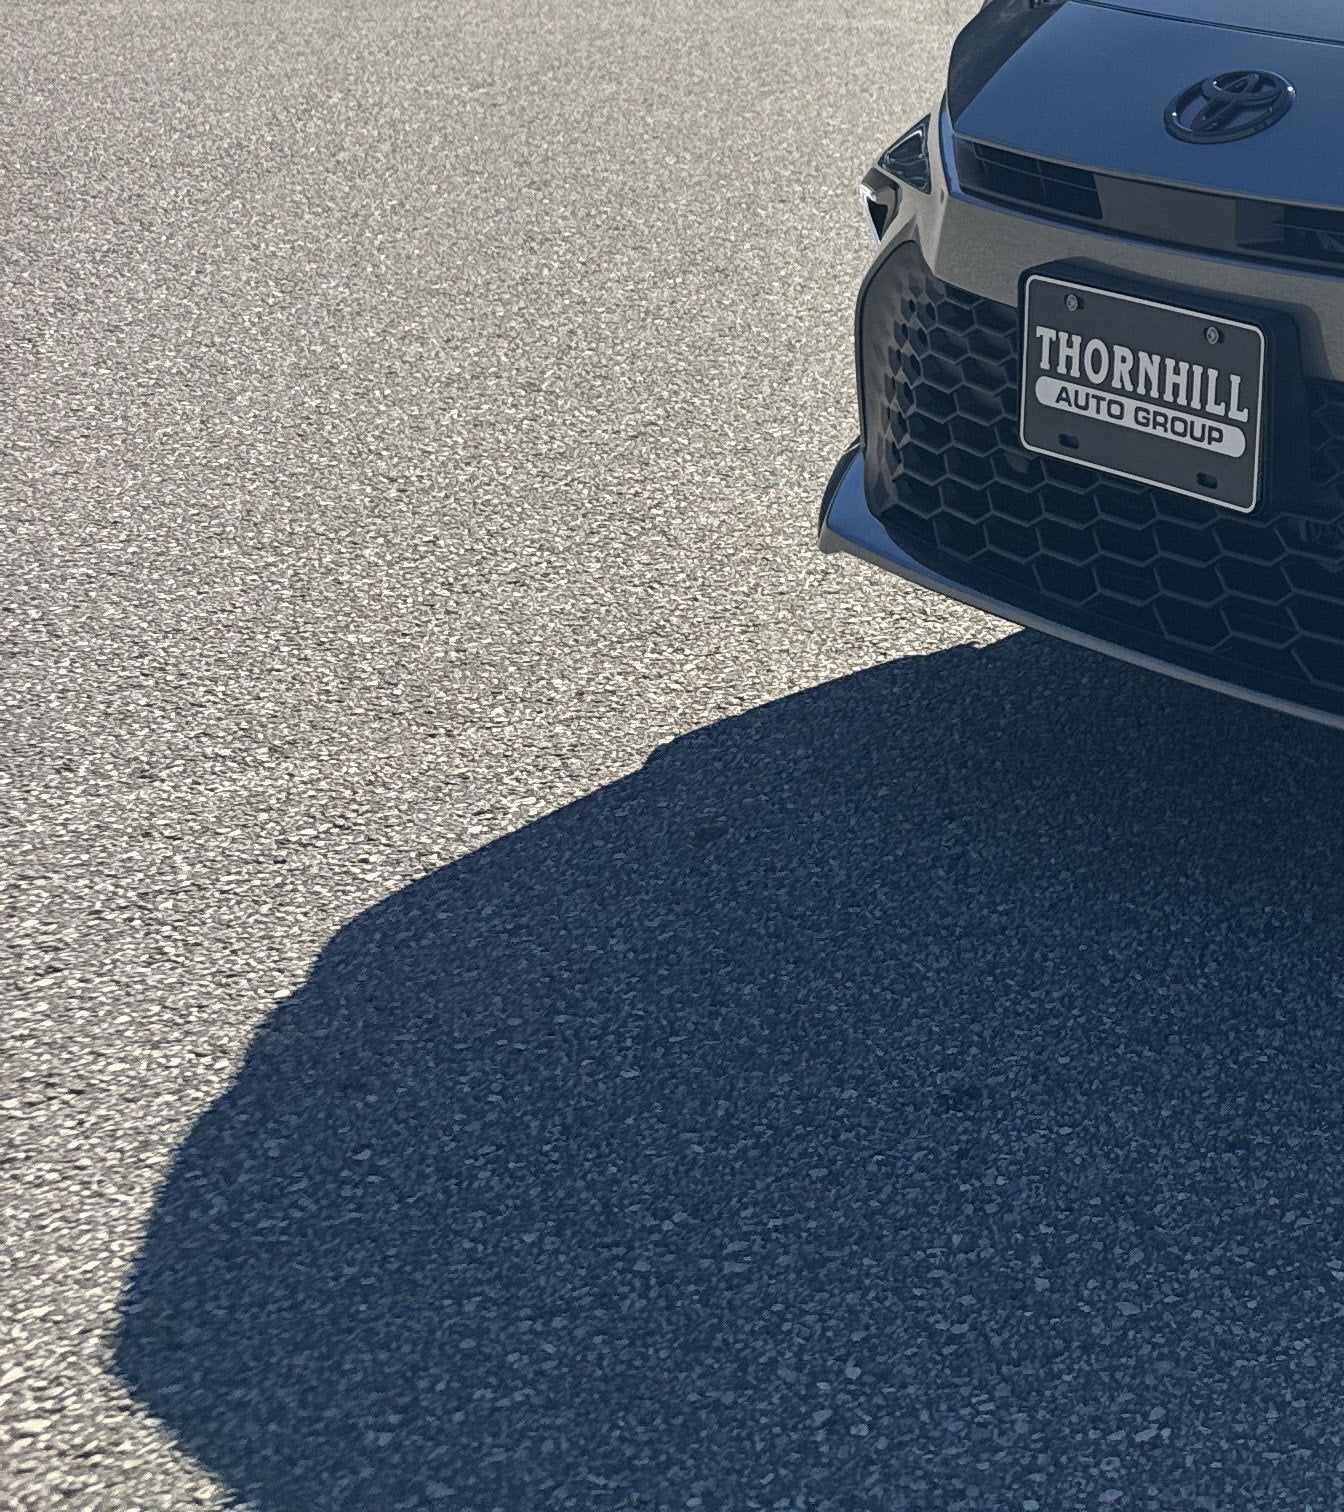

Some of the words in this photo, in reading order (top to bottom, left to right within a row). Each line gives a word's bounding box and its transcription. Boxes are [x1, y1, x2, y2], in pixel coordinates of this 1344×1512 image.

[1036, 325, 1249, 423] THORNHILL
[1055, 386, 1125, 420] AUTO
[1134, 406, 1224, 446] GROUP
